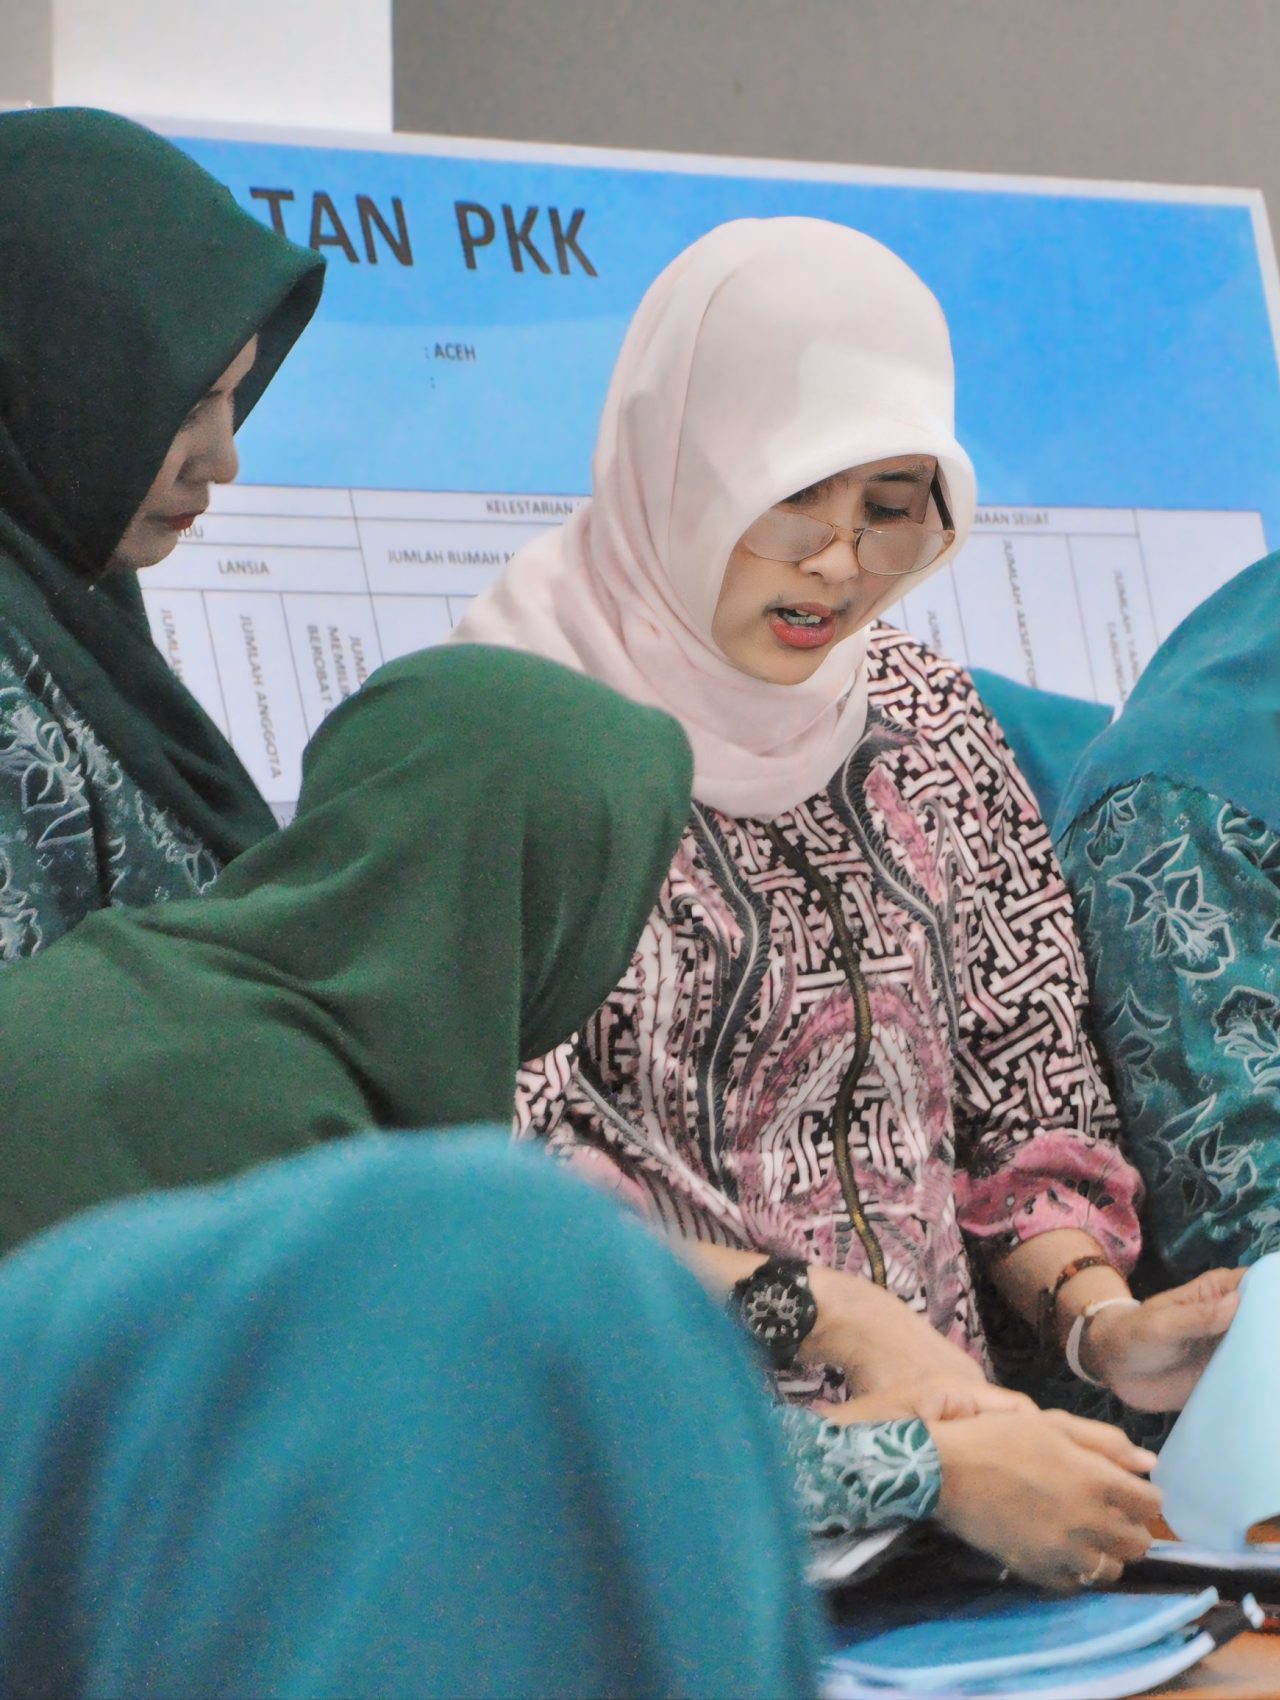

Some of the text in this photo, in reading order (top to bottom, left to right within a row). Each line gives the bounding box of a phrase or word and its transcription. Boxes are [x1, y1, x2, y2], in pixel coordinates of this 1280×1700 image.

[454, 200, 599, 278] PKK
[434, 343, 476, 361] ACEH
[486, 500, 573, 515] KELESTARIAN
[388, 549, 444, 565] JUMLAH
[447, 551, 500, 566] RUMAH
[218, 559, 271, 576] LANSIA
[240, 614, 282, 780] JUMLAH ANGGOTA
